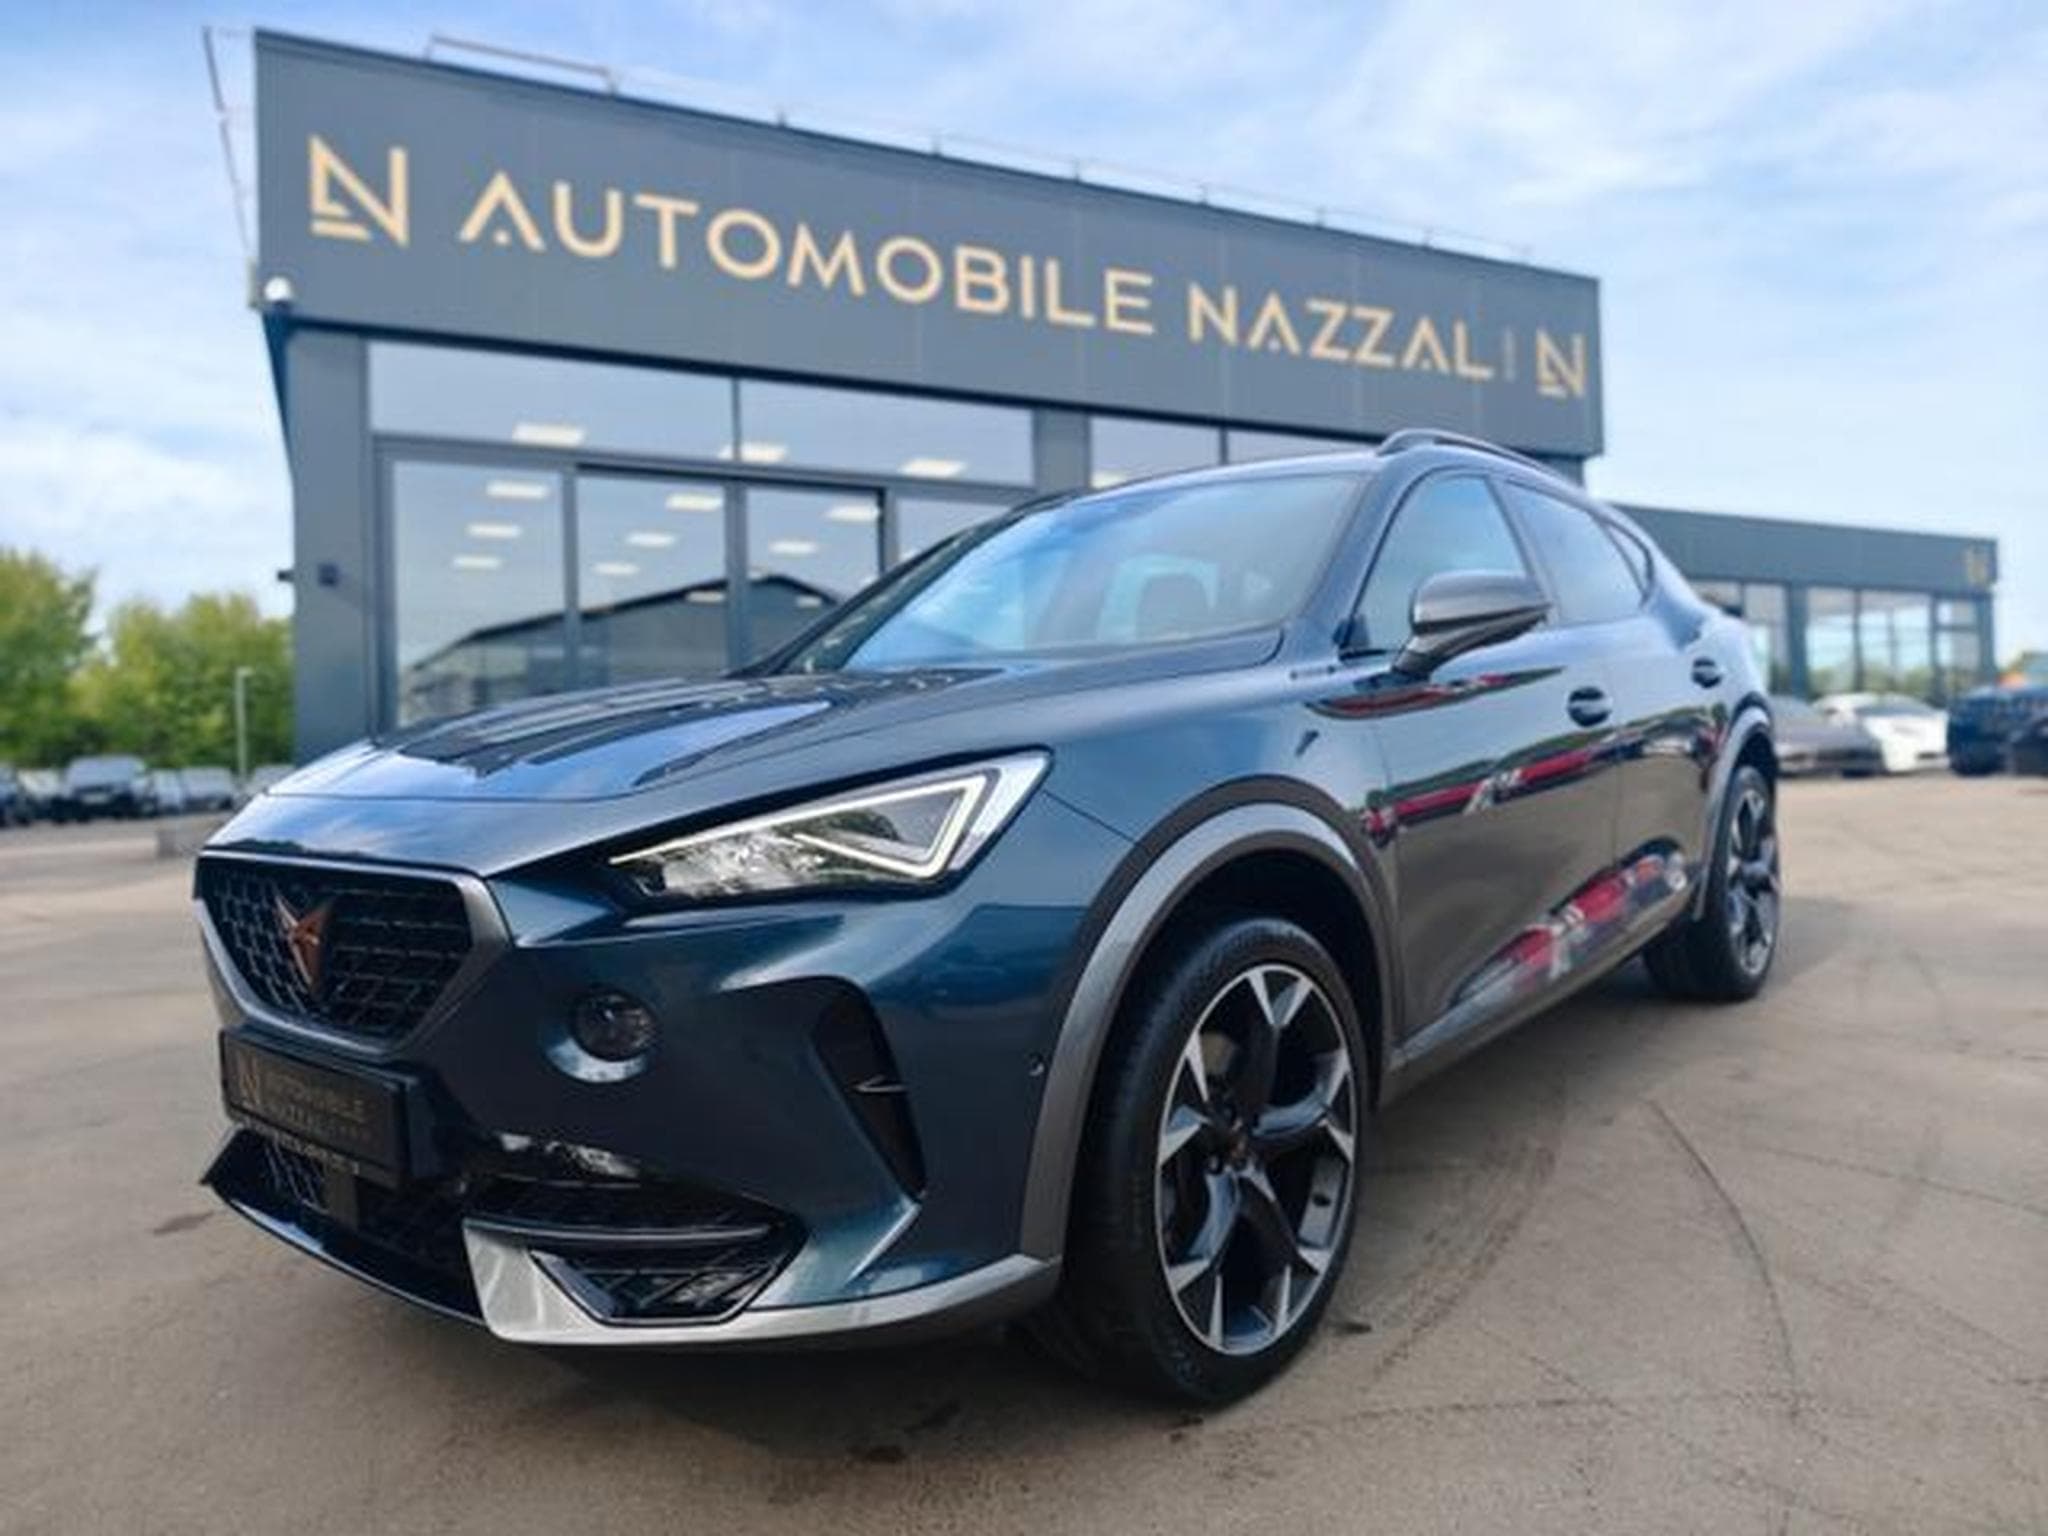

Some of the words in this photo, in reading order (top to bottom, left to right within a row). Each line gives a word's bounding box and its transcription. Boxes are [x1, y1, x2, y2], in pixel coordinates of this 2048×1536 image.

[309, 134, 409, 248] N
[459, 171, 1156, 335] AUTOMOBILE
[1188, 283, 1494, 380] NAZZAL
